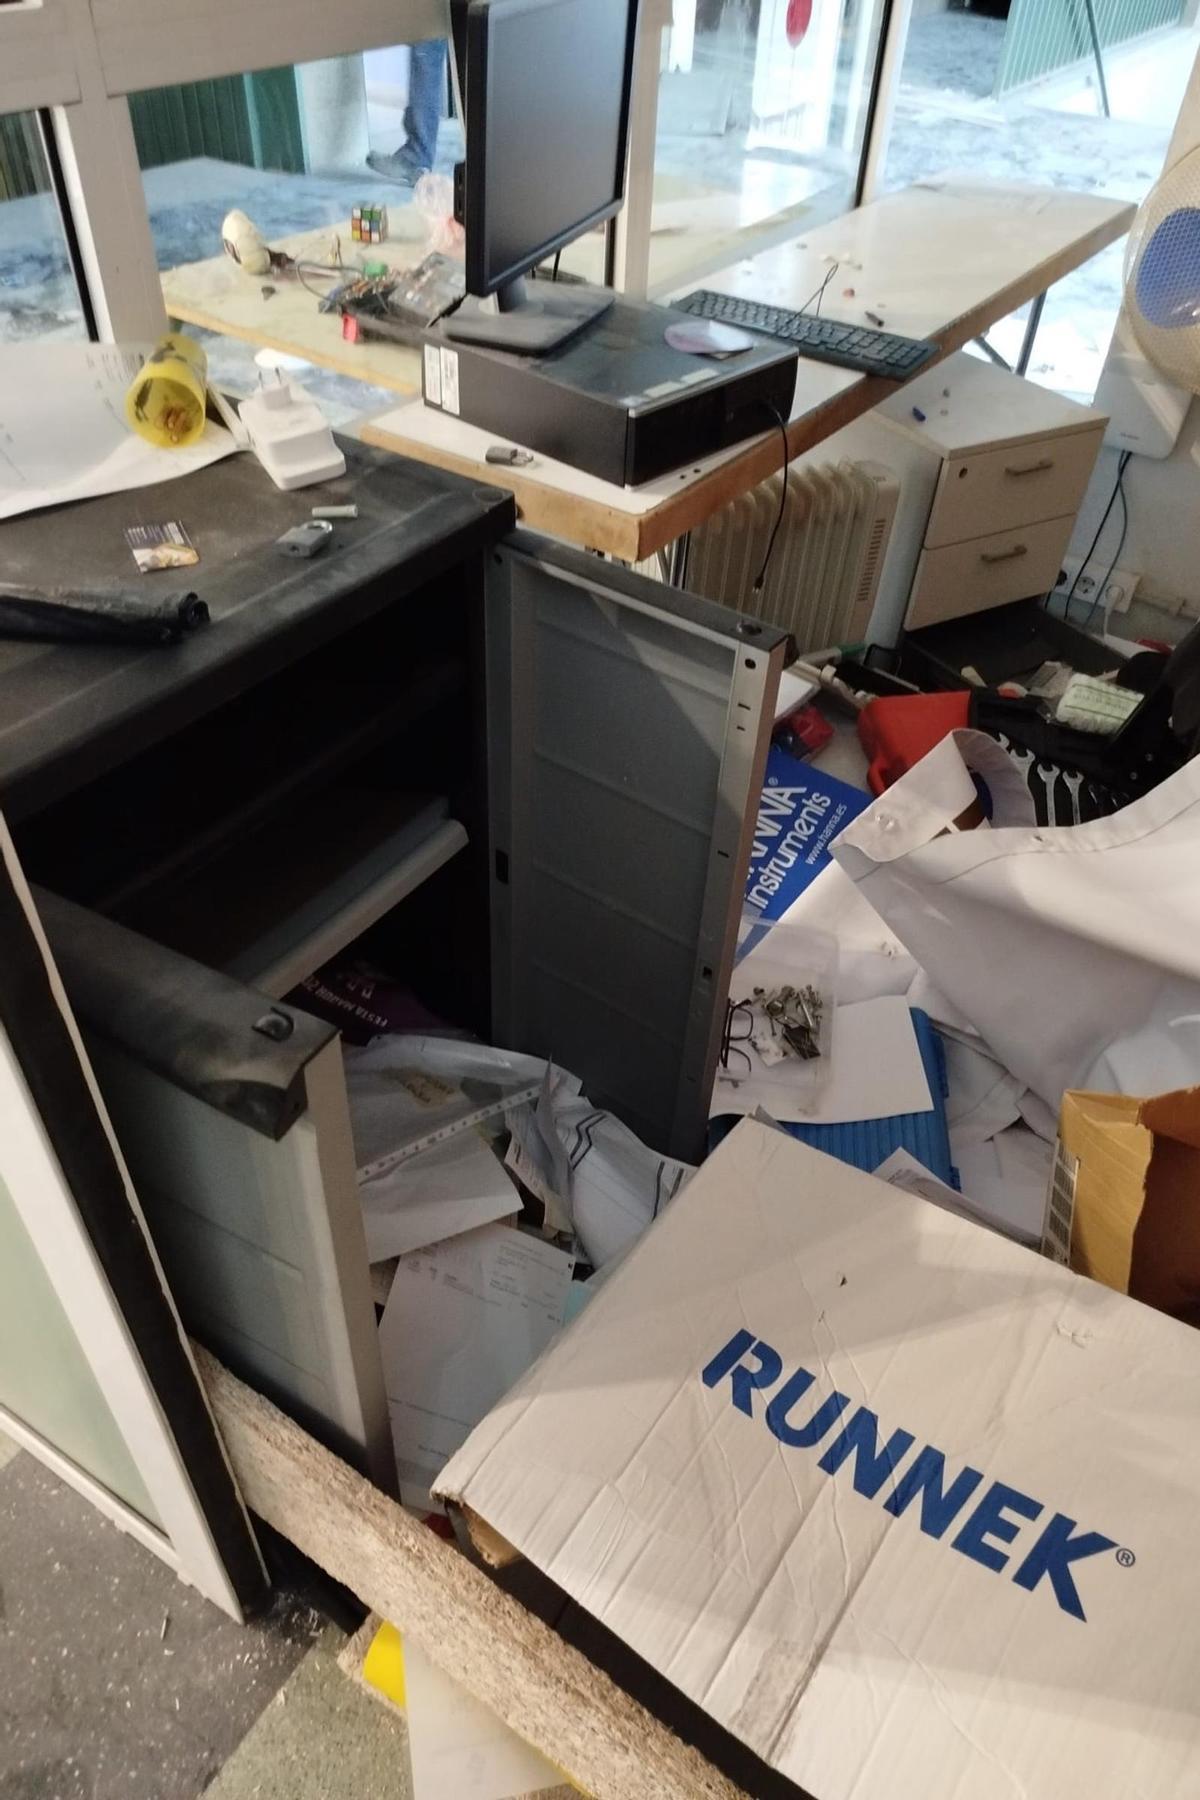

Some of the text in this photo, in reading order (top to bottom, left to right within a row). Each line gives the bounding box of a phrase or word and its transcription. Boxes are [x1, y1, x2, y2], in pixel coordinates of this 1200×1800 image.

[744, 792, 832, 910] instruments
[805, 804, 848, 865] www.hanna.es
[355, 1005, 388, 1028] FESTA
